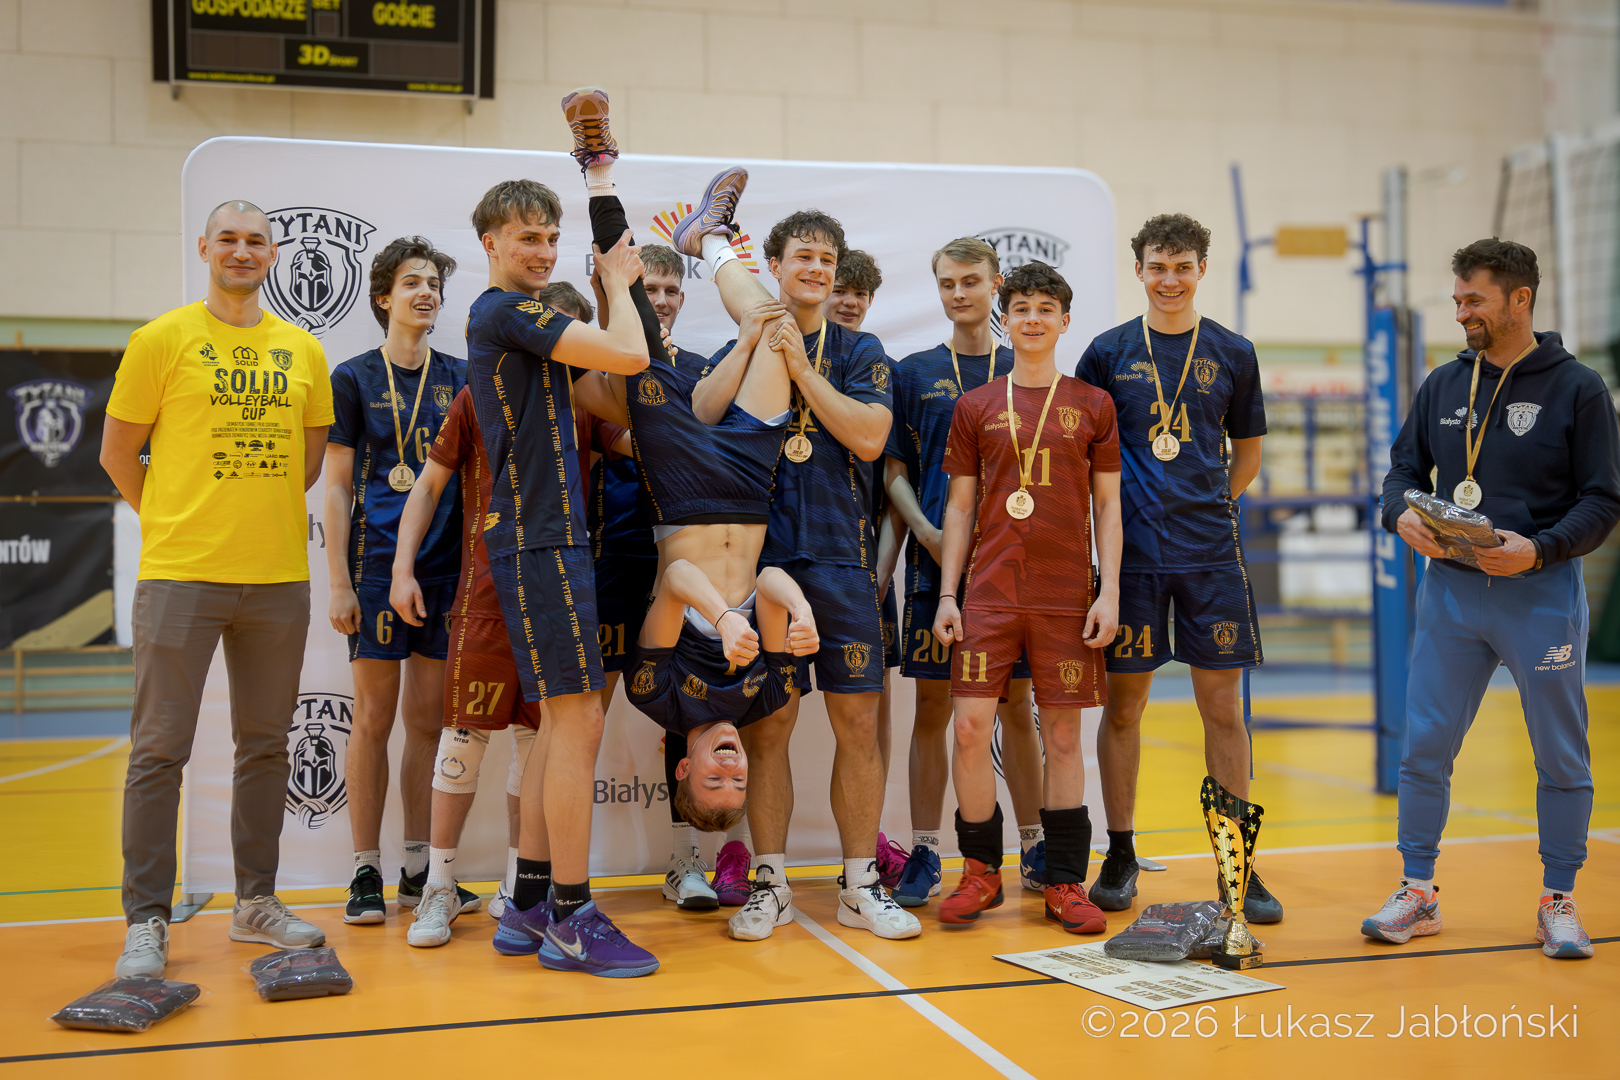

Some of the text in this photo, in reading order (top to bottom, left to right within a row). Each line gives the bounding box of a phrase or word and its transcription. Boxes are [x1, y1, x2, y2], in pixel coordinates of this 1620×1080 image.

[297, 46, 331, 65] 3D
[981, 233, 1057, 261] YTANI
[213, 368, 288, 395] SOLID
[210, 394, 292, 408] VOLLEYBALL
[241, 407, 266, 420] CUP
[369, 402, 393, 410] Białysto
[1148, 401, 1192, 442] 24
[1440, 418, 1461, 426] Białysto
[415, 427, 431, 463] 6
[1021, 448, 1052, 486] 11
[376, 610, 394, 645] 6
[599, 623, 626, 657] 21
[1114, 624, 1154, 658] 24
[844, 643, 871, 652] TYTANI
[960, 650, 988, 683] 11
[1551, 660, 1576, 671] balance
[465, 680, 506, 716] 27
[593, 776, 669, 809] Białys
